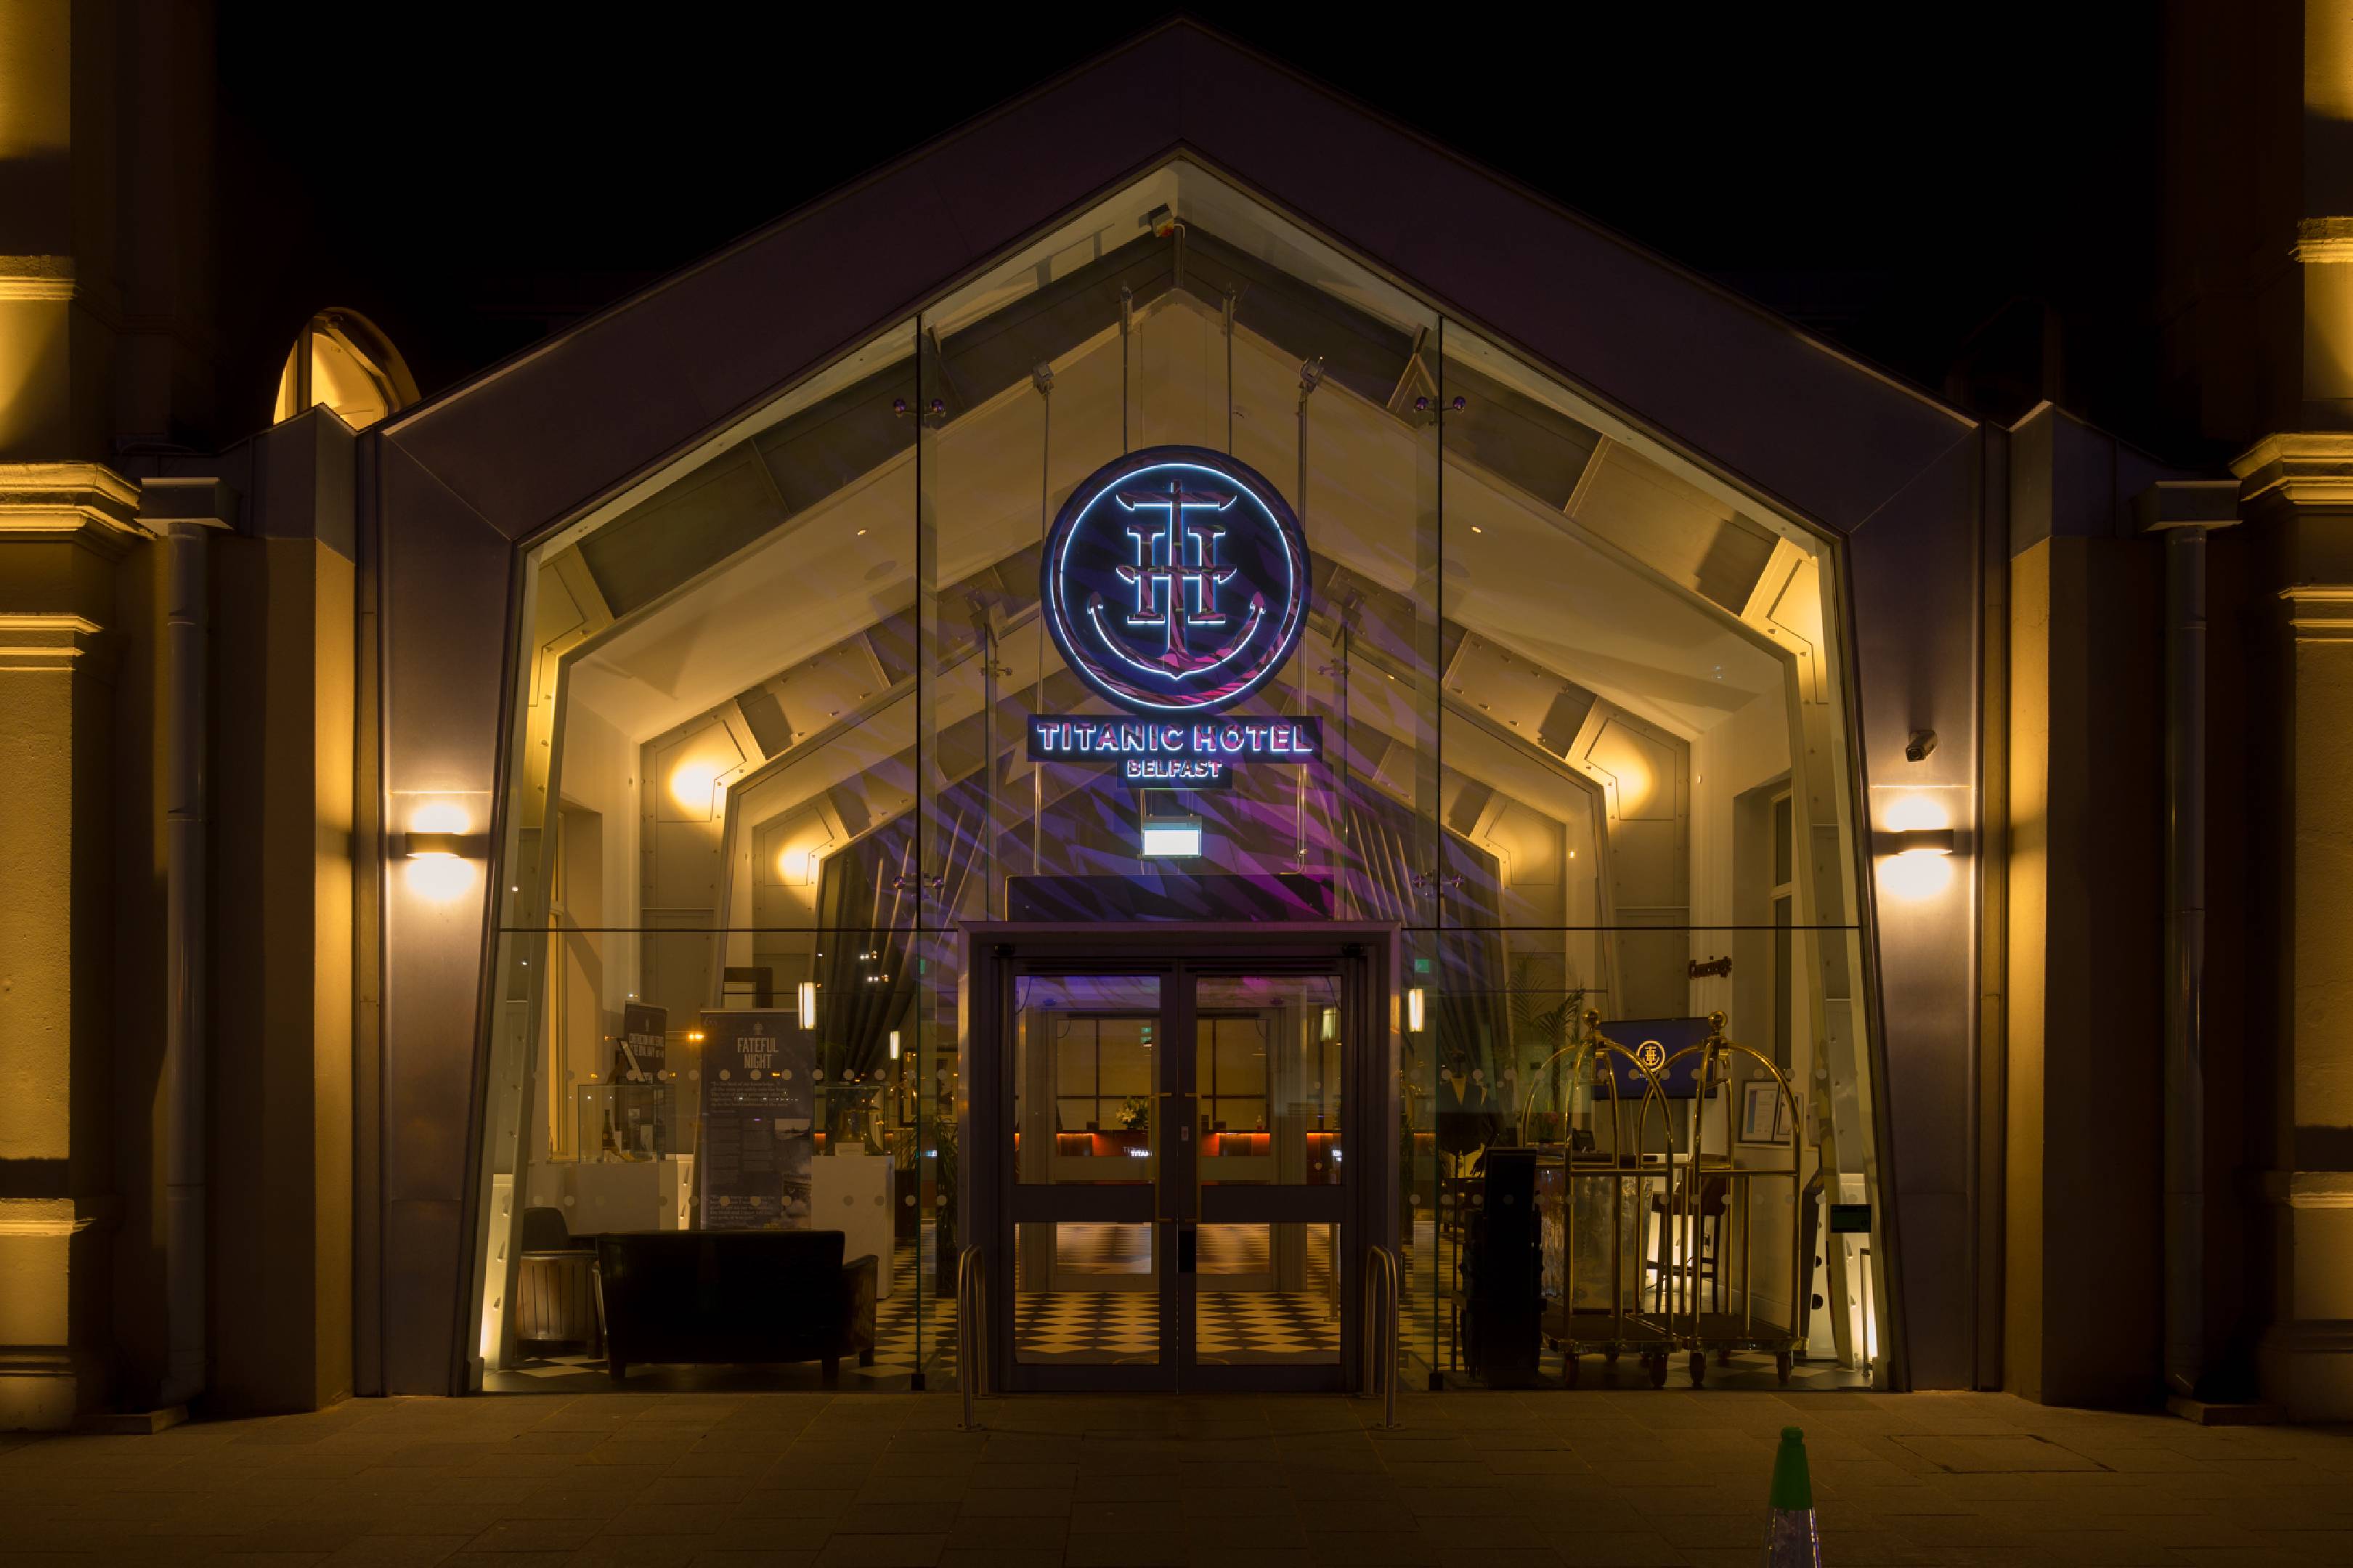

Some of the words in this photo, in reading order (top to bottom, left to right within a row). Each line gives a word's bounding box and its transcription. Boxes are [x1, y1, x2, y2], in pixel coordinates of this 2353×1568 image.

[1037, 723, 1184, 751] TITANIC
[1193, 723, 1313, 752] HOTEL
[1126, 759, 1223, 778] BELFAST
[737, 1037, 779, 1053] FATEFUL
[744, 1053, 773, 1069] NIGHT
